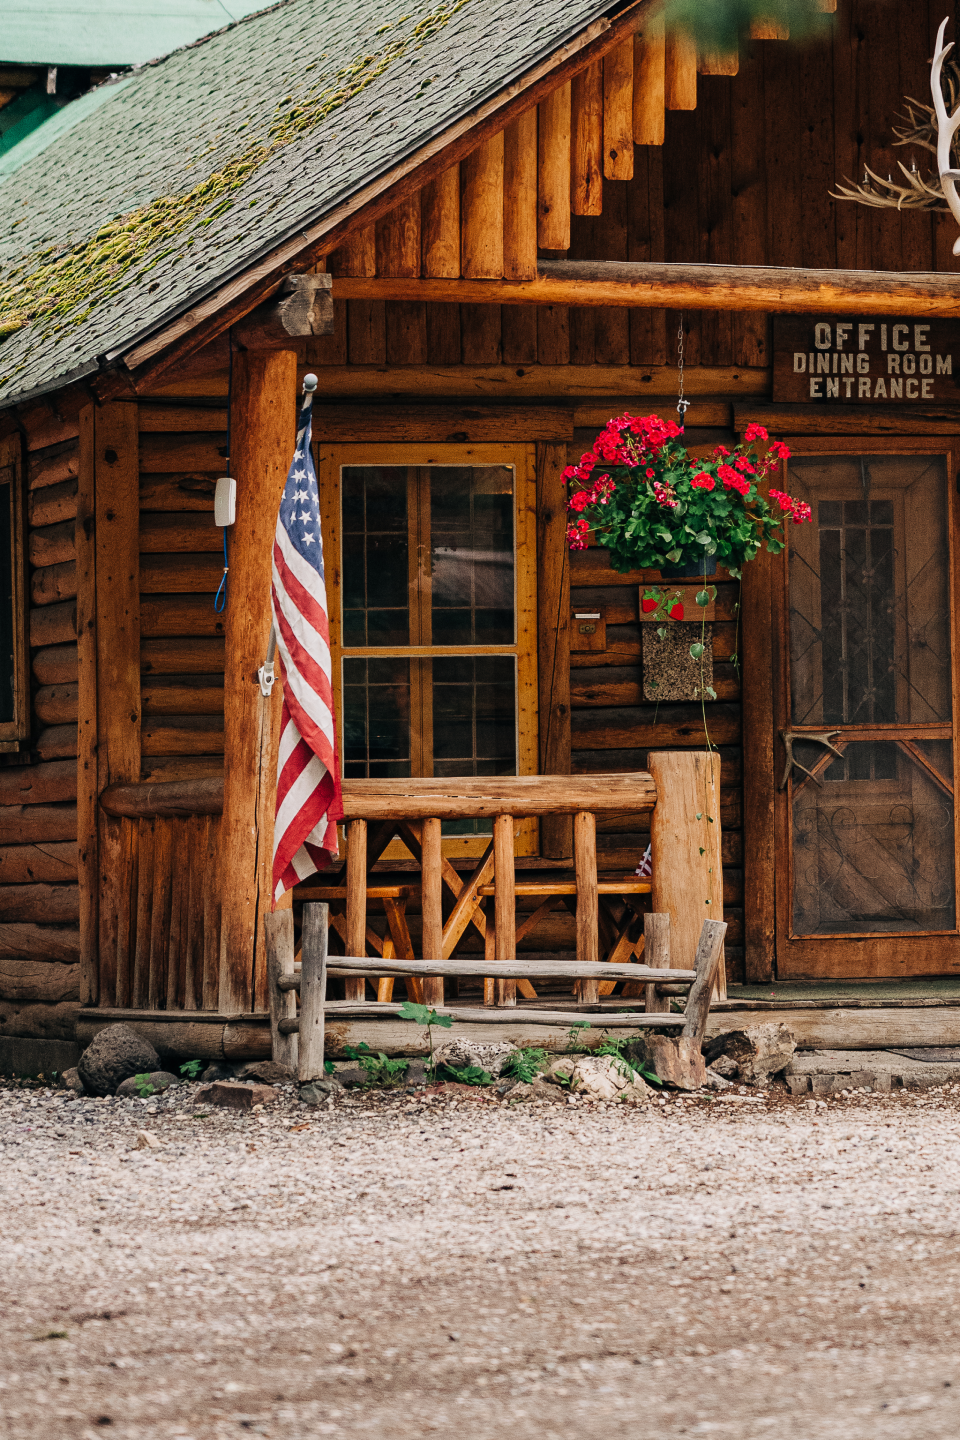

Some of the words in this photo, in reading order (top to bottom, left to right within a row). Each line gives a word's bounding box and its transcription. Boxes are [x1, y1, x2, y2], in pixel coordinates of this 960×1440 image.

[814, 322, 931, 352] OFFICE
[793, 352, 870, 374] DINING
[887, 353, 953, 375] ROOM
[809, 377, 935, 399] ENTRANCE
